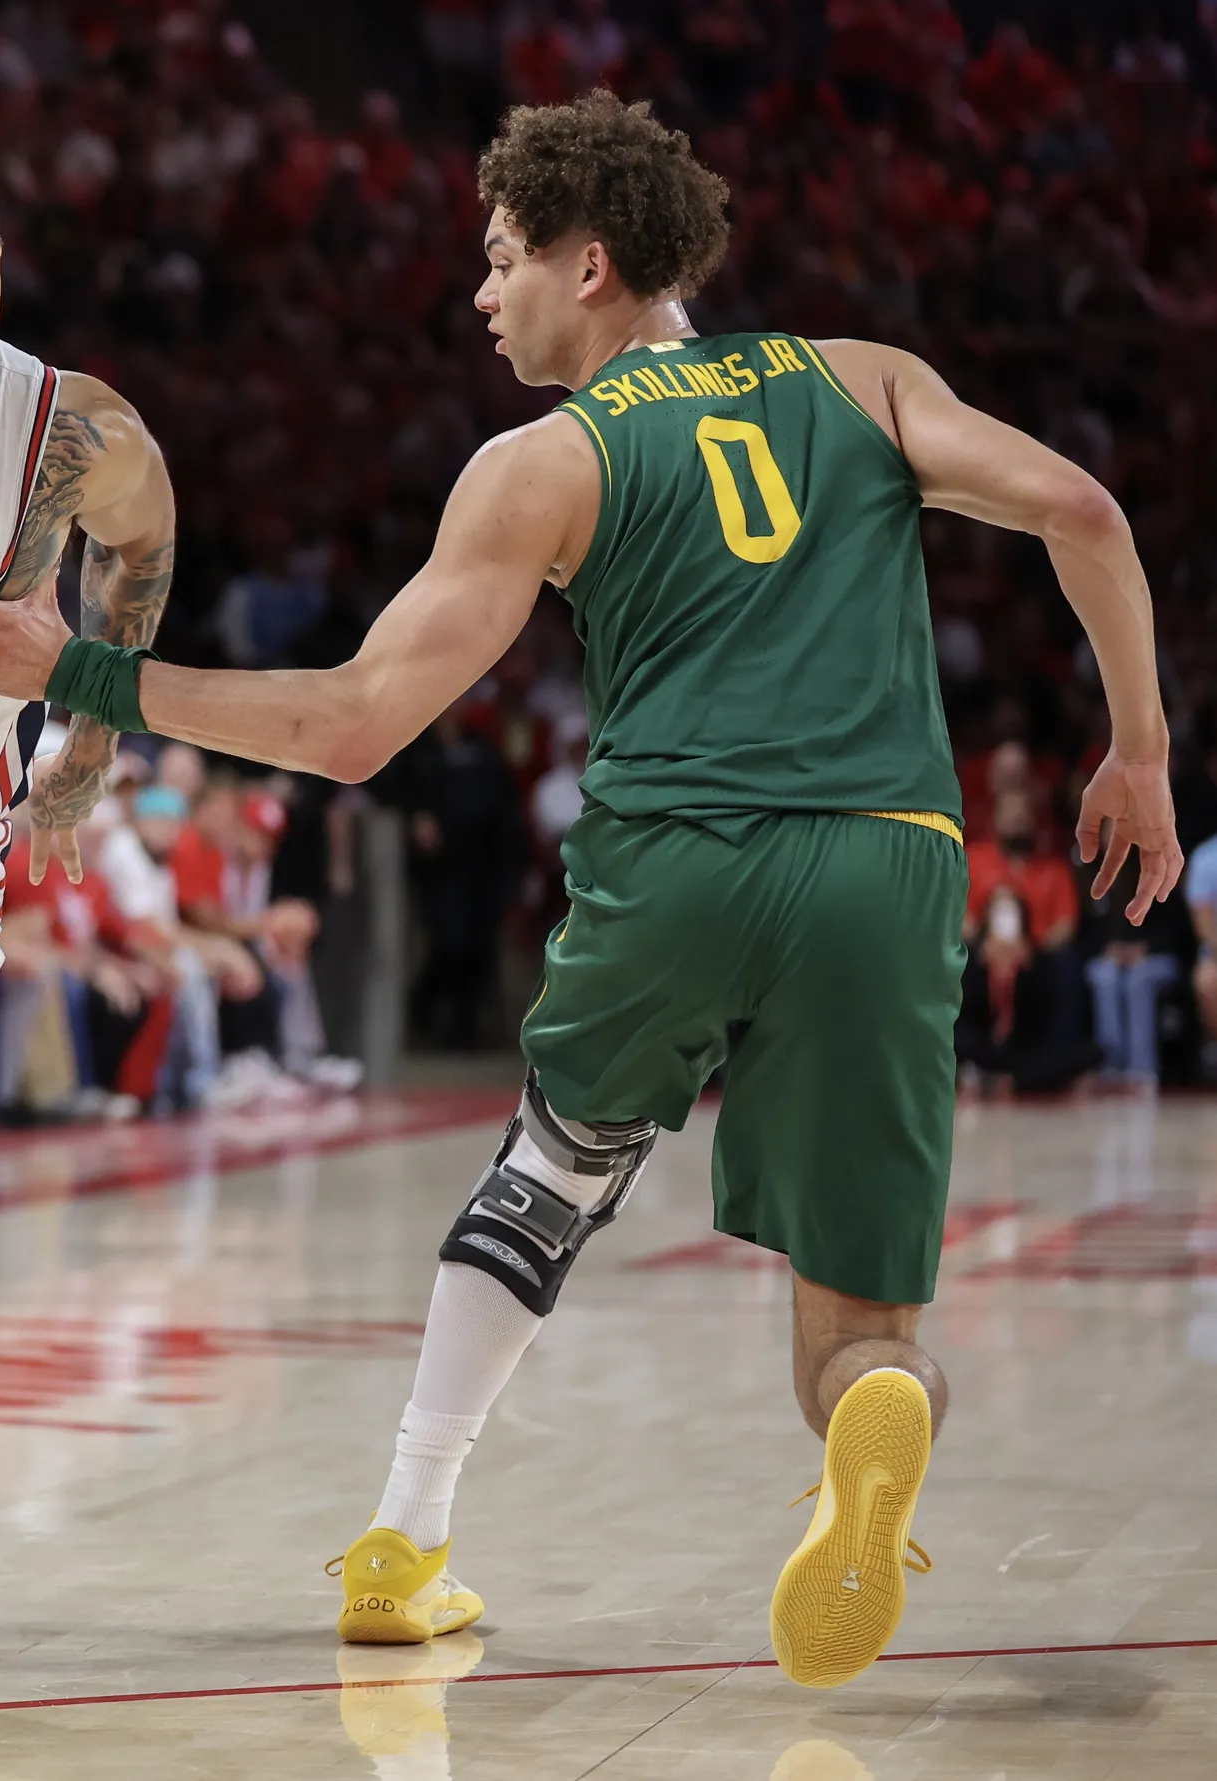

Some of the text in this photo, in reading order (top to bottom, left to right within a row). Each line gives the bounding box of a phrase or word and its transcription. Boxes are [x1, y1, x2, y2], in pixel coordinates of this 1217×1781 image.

[589, 338, 808, 417] SKILLINGS JR
[695, 415, 802, 564] 0
[469, 1233, 531, 1269] DONJOY
[353, 1597, 395, 1613] GOD
